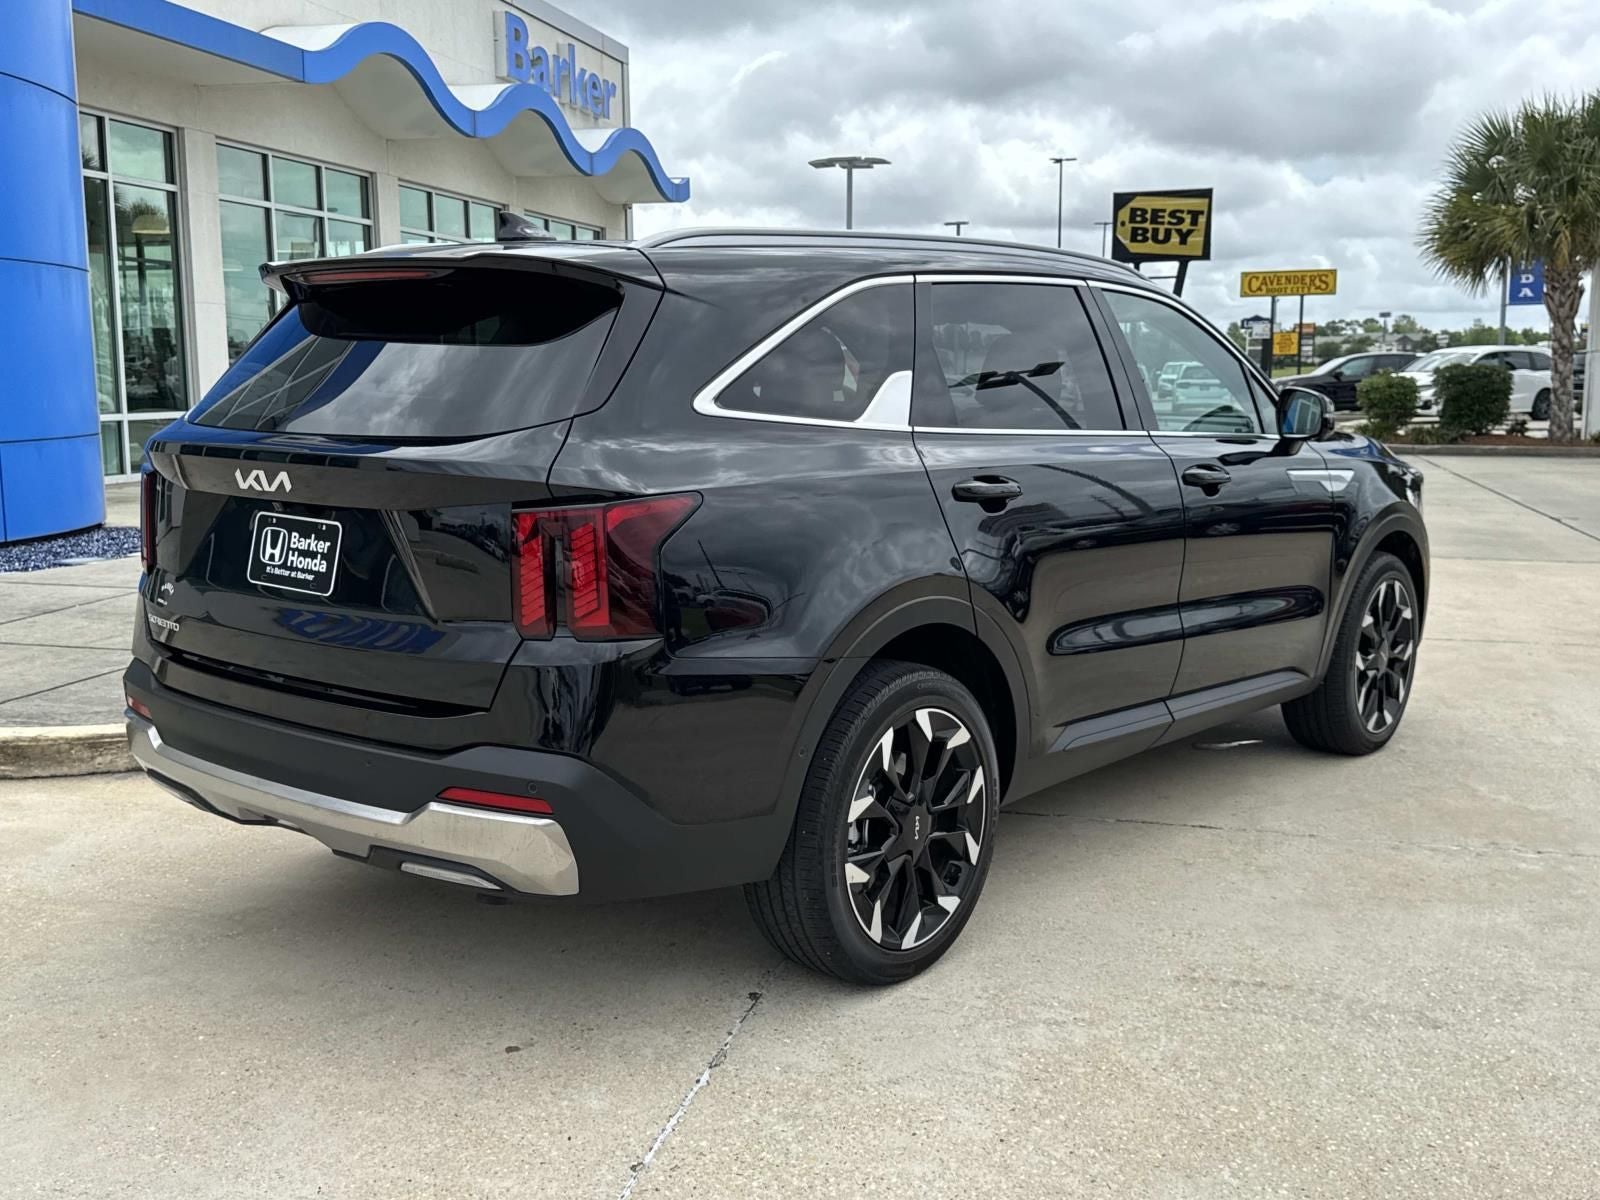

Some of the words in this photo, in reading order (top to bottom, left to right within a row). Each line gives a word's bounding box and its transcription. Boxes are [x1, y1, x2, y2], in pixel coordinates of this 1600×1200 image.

[505, 10, 617, 120] Barker
[1128, 207, 1205, 227] BEST
[1129, 226, 1196, 246] BUY
[1247, 273, 1330, 294] CAVENDER'S
[1265, 286, 1288, 294] BOOT
[1290, 285, 1312, 293] CITY
[234, 467, 292, 493] KIA
[290, 531, 331, 554] Barker
[287, 550, 327, 573] Honda
